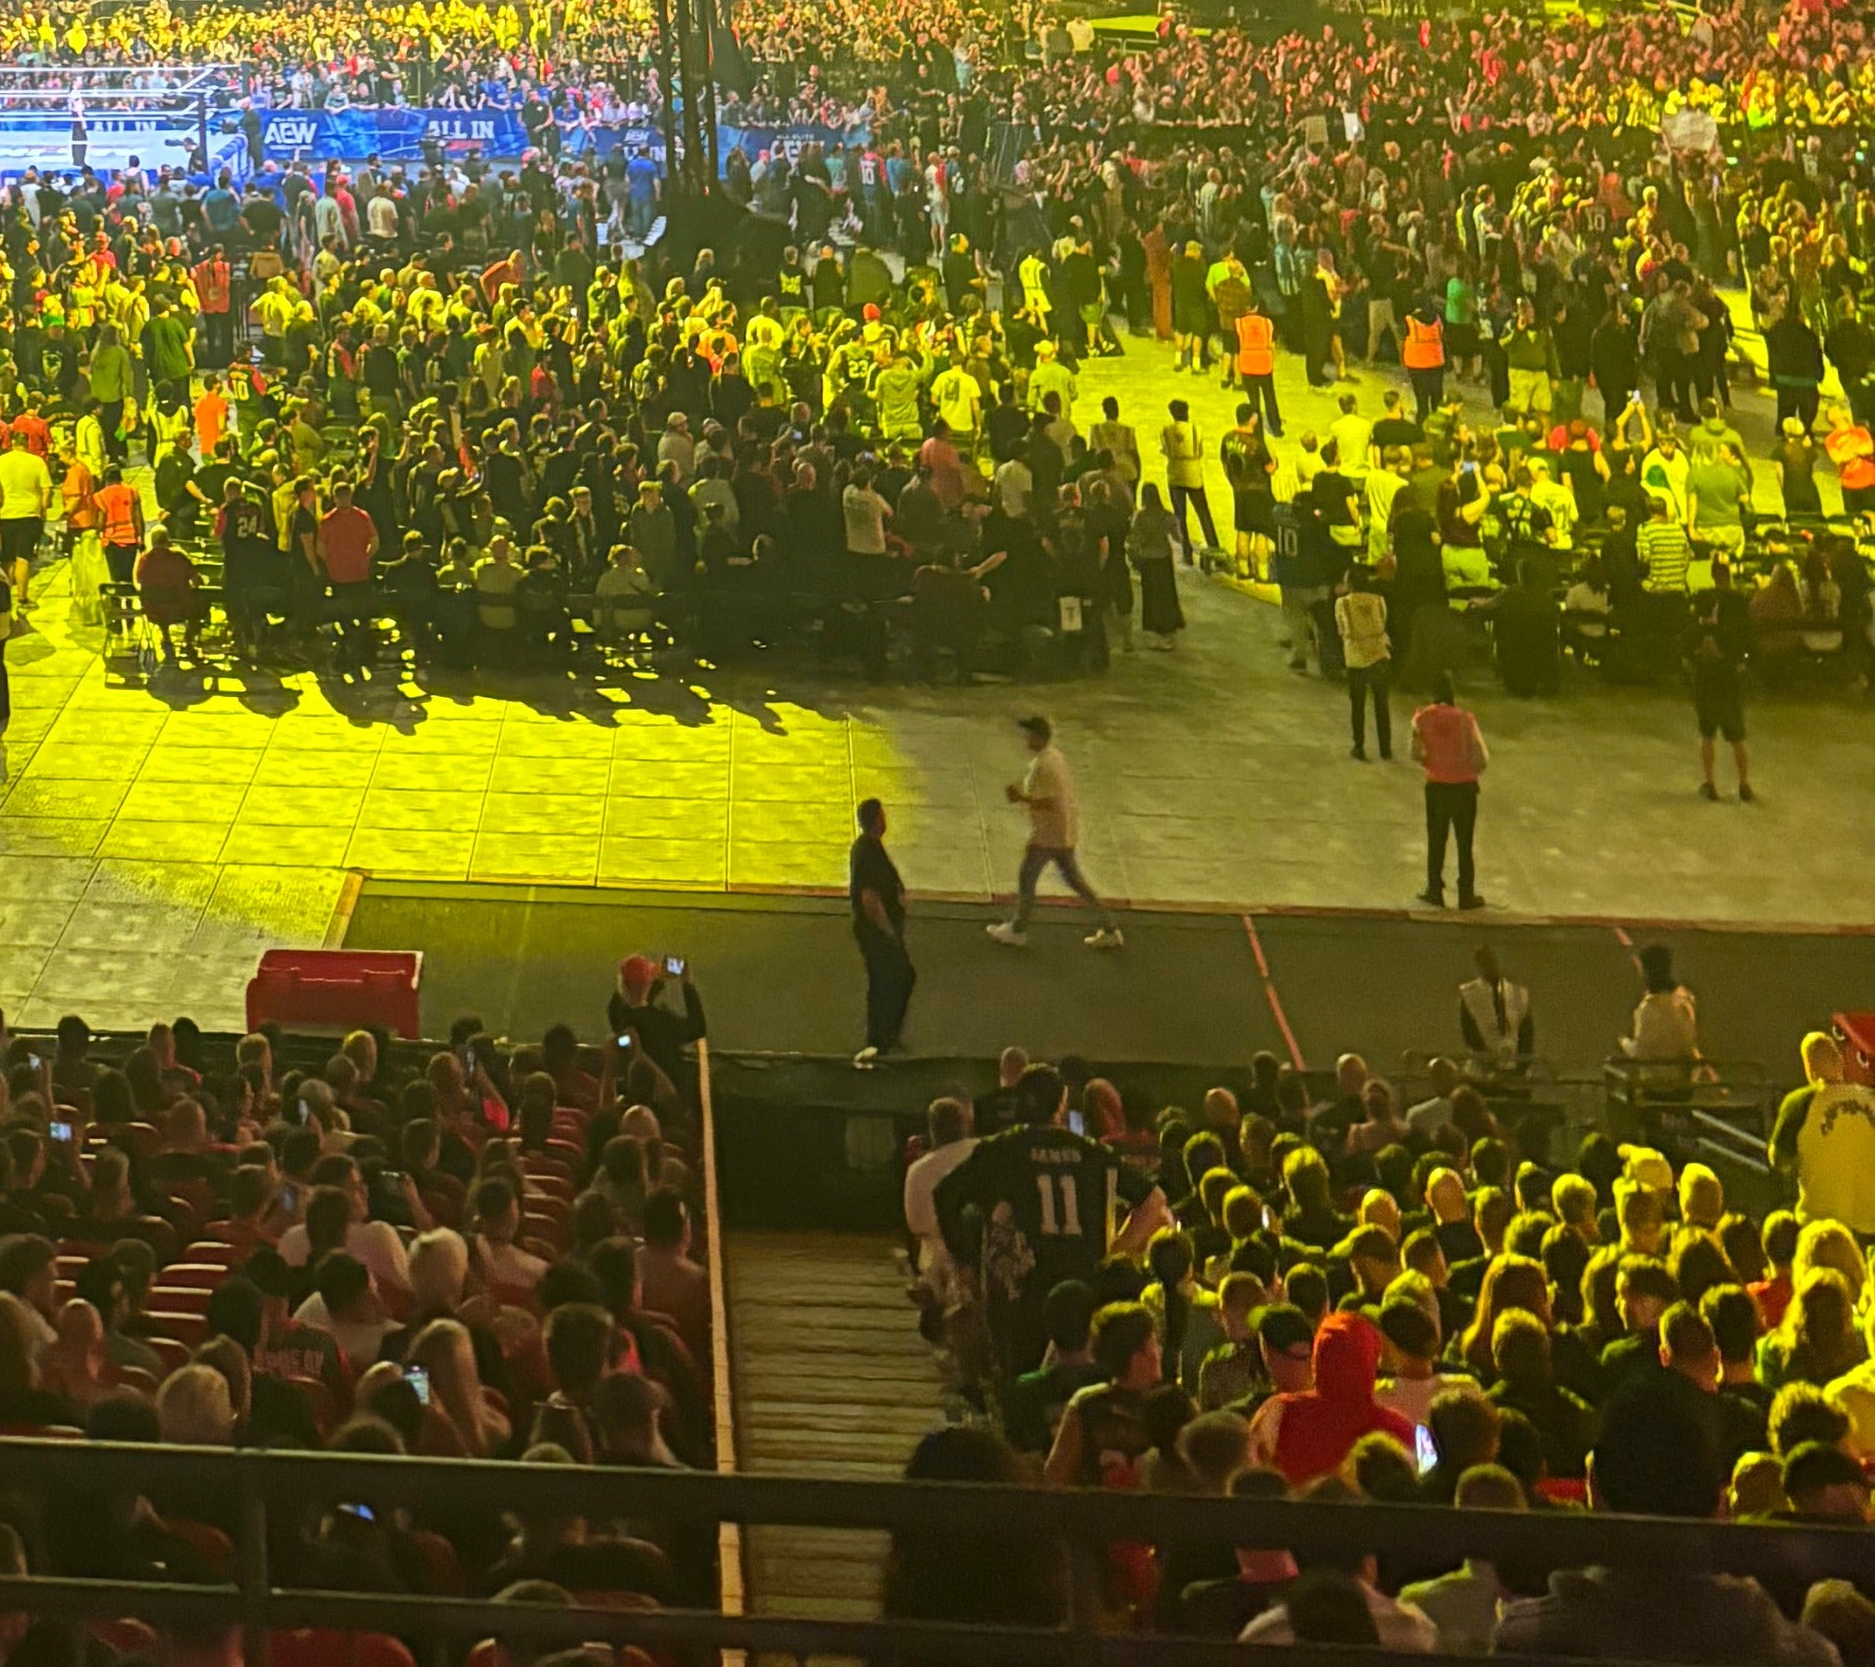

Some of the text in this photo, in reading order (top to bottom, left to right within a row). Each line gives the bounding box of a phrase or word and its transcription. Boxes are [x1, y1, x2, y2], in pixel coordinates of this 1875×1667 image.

[264, 122, 318, 144] AEW
[428, 120, 495, 140] ALL IN
[237, 515, 258, 539] 24
[1277, 525, 1298, 557] 10
[1036, 1173, 1082, 1236] 11
